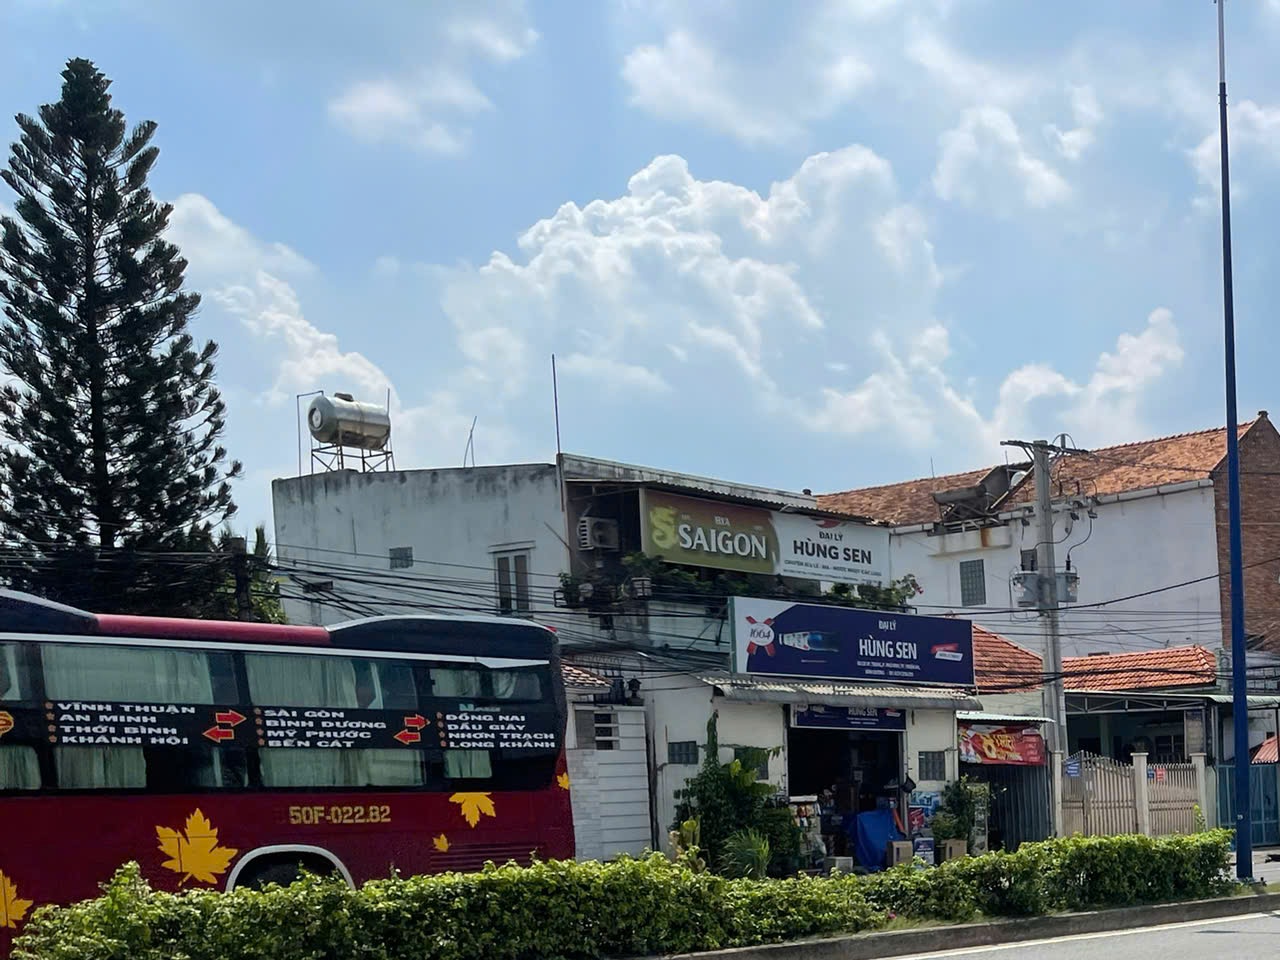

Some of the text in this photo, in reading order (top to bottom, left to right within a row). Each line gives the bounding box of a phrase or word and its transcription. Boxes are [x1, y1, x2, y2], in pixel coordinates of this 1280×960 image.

[714, 516, 731, 526] BIA
[678, 523, 767, 559] SAIGON
[793, 538, 872, 564] HÙNG SEN
[750, 628, 771, 639] 1664
[859, 634, 917, 660] HÙNG SEN
[119, 704, 196, 714] THUẬN
[264, 709, 344, 718] SÀI GÒN
[59, 714, 157, 723] AN MINH
[265, 718, 387, 729] BÌNH DƯƠNG
[124, 725, 177, 735] BÌNH
[267, 729, 371, 739] MỸ PHƯỚC
[268, 738, 355, 748] BẾN CÁT
[289, 805, 391, 824] 50F-022.82
